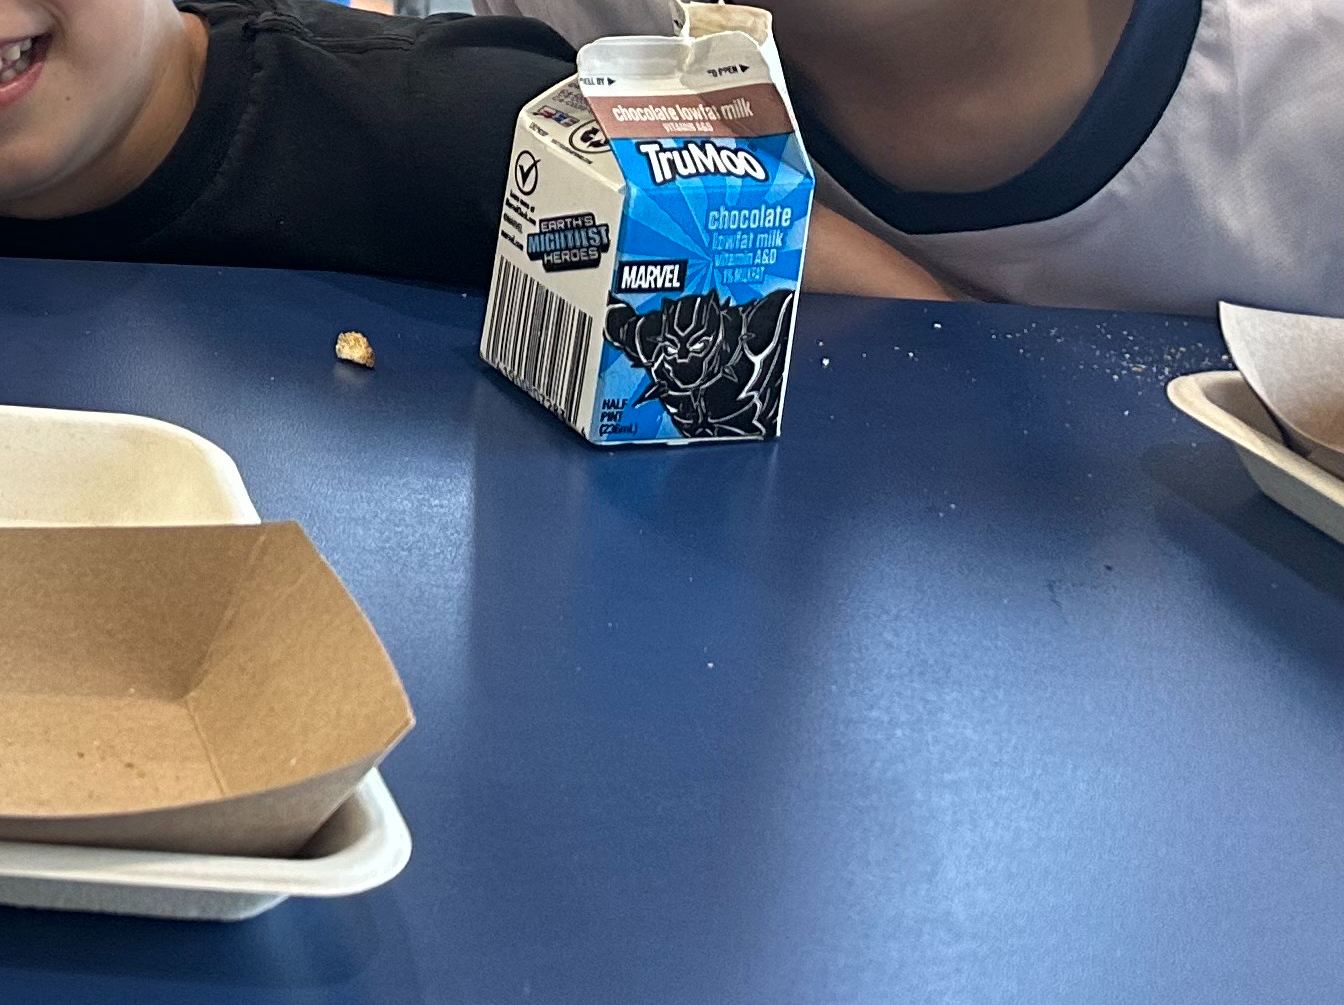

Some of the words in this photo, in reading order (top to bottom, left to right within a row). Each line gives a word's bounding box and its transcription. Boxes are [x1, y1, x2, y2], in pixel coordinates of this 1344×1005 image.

[612, 105, 677, 123] chocolate
[677, 102, 720, 121] lowfat
[721, 98, 754, 121] milk
[638, 141, 767, 185] TruMoo
[541, 215, 594, 232] EARTH'S
[708, 204, 792, 230] chocolate
[528, 226, 610, 254] MIGHTIEST
[712, 231, 754, 250] lowfat
[756, 229, 784, 249] milk
[544, 247, 600, 265] HEROES
[714, 250, 753, 267] vitamin
[754, 248, 777, 265] A&D
[621, 265, 681, 289] MARVEL
[602, 399, 628, 410] HALF
[600, 411, 624, 422] PINT
